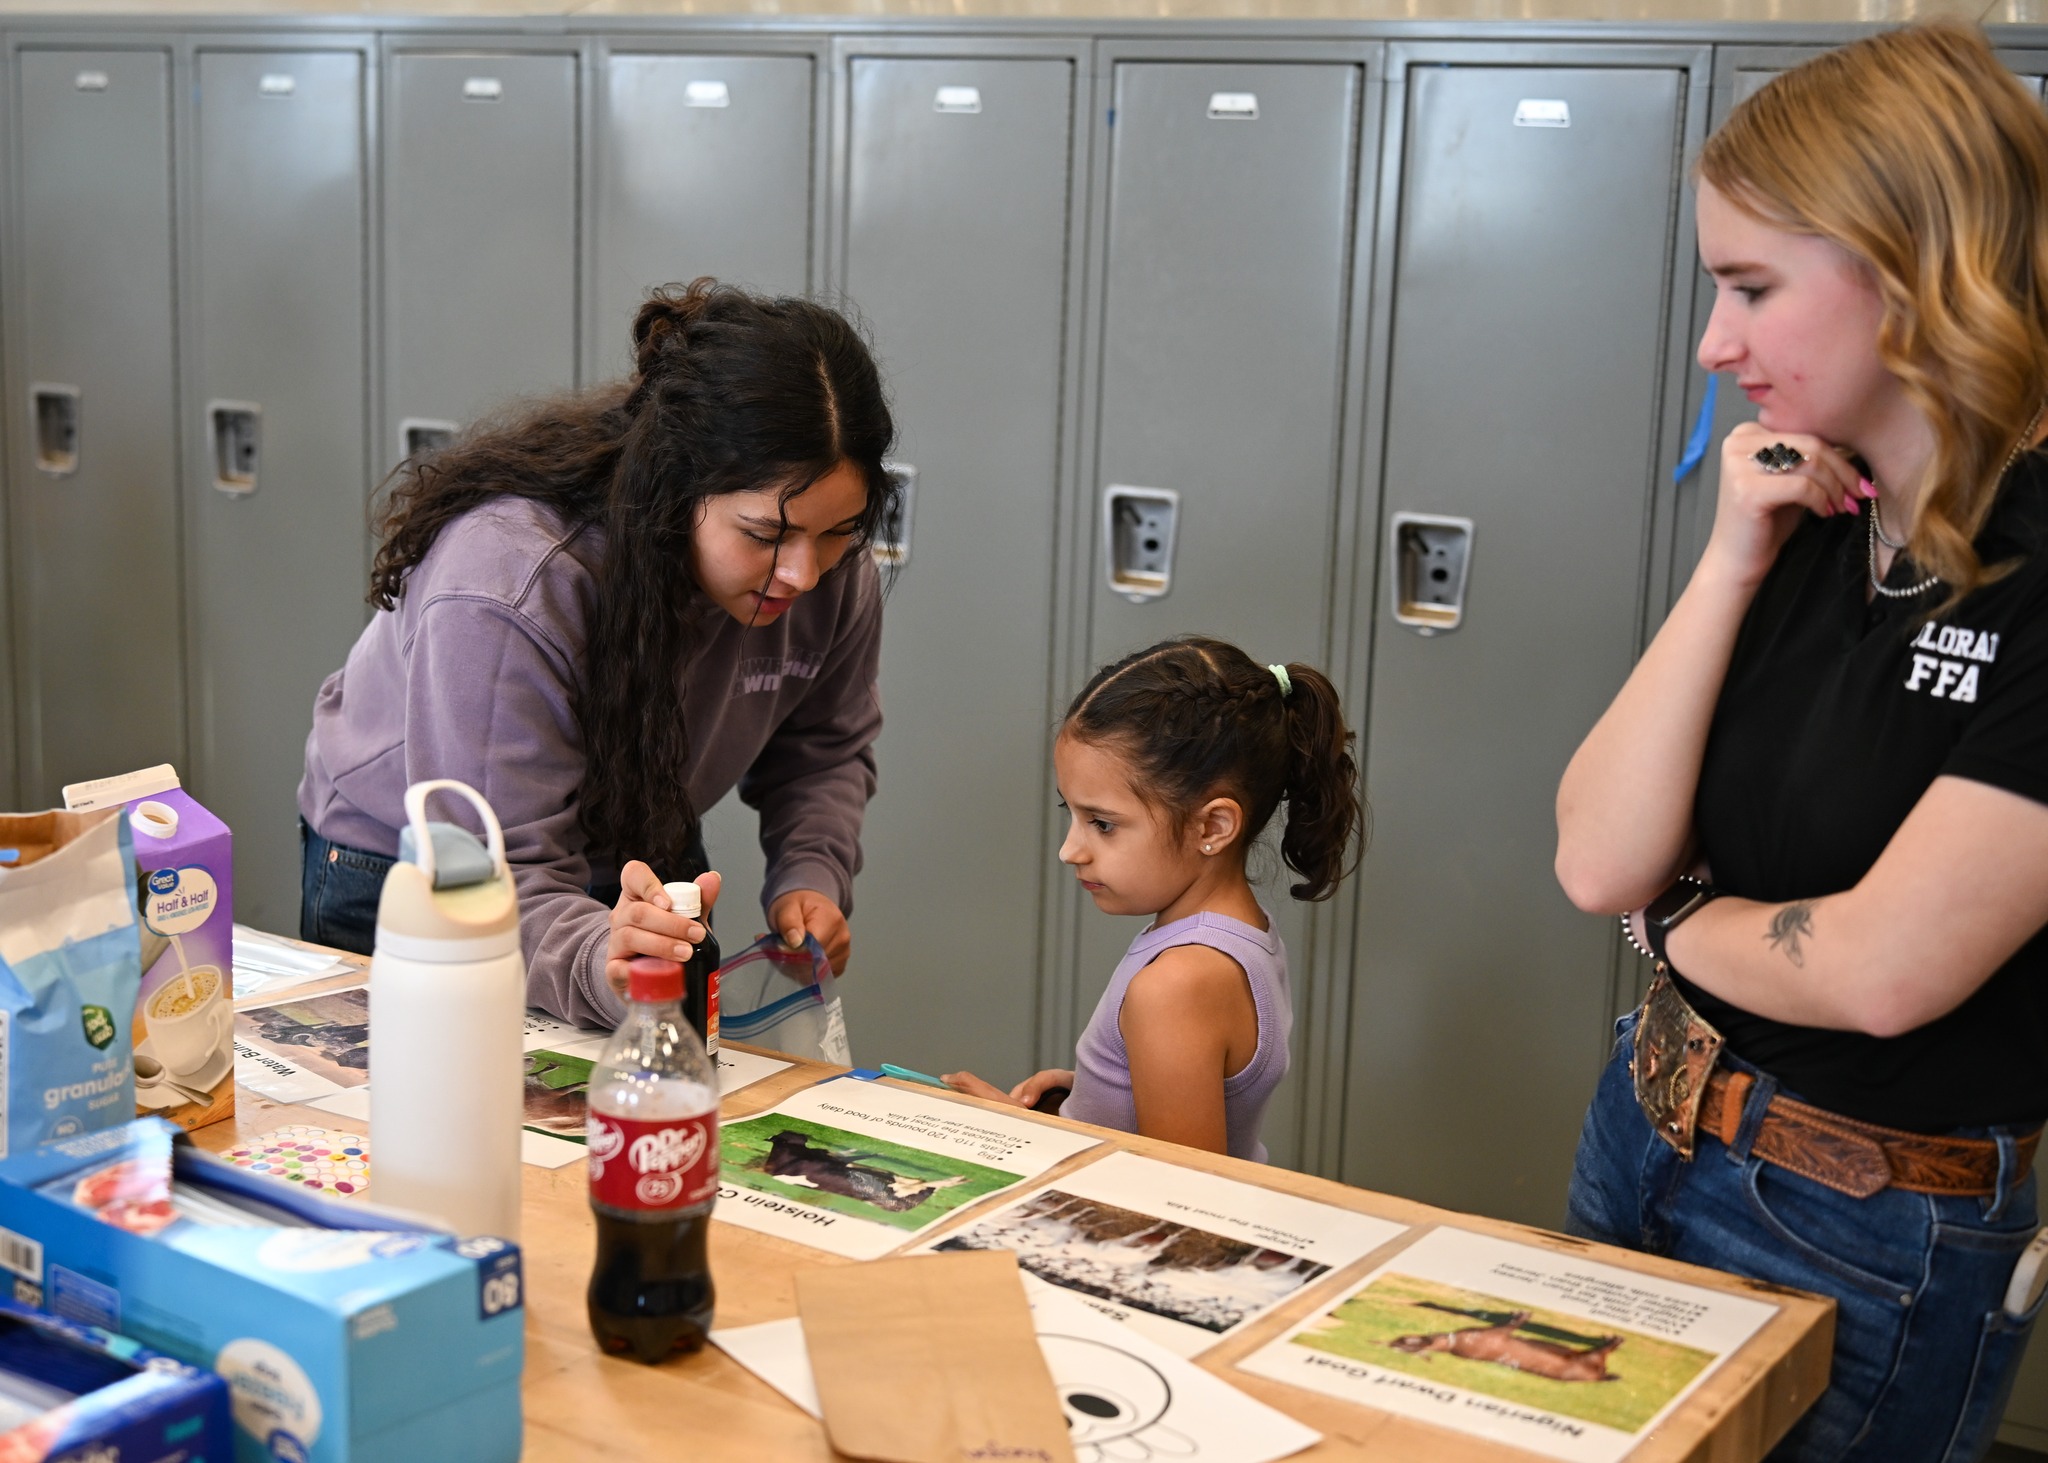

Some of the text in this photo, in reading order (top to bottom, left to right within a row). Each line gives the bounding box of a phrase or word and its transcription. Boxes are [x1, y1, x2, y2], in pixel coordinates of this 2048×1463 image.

[1904, 653, 1980, 703] FFA
[152, 873, 175, 886] Great
[157, 898, 179, 914] Half
[180, 896, 188, 908] &
[190, 889, 209, 905] Half
[255, 1058, 296, 1077] Water
[816, 1102, 844, 1113] daily
[843, 1110, 870, 1119] food
[56, 1122, 77, 1135] NO
[885, 1119, 928, 1133] pounds
[886, 1113, 1015, 1147] Produces the most Milk
[963, 1126, 1006, 1138] Gallons
[927, 1131, 948, 1139] 120
[977, 1151, 997, 1160] Big
[979, 1144, 1006, 1154] Eats
[743, 1195, 836, 1227] Holstein
[1303, 1355, 1586, 1438] Nigerian Dwarf Goat
